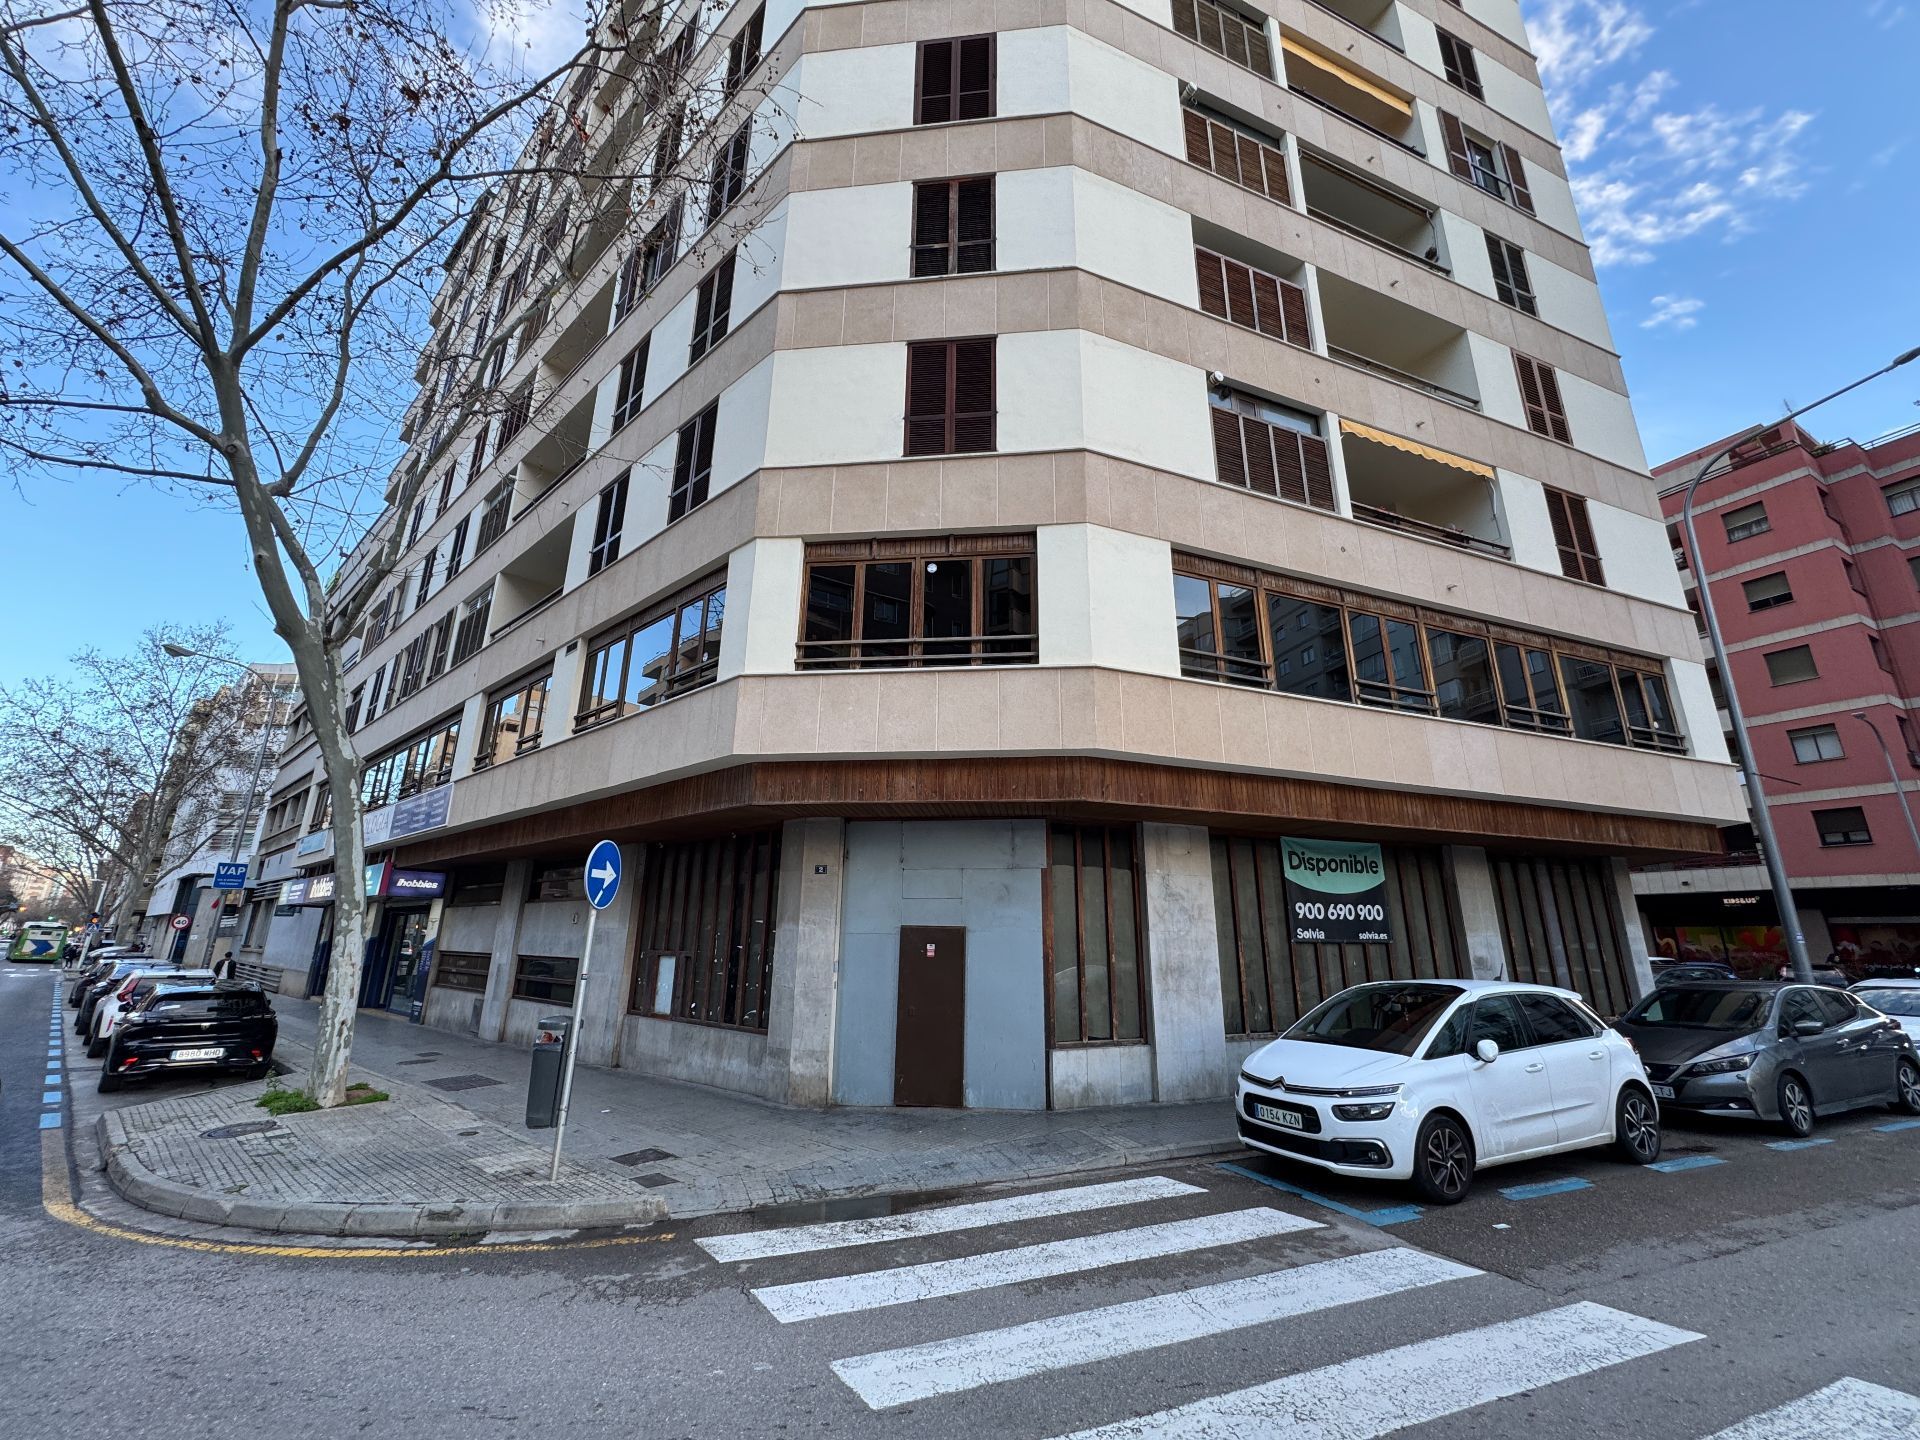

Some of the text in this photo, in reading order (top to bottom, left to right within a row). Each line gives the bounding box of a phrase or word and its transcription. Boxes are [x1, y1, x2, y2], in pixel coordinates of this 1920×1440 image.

[219, 865, 246, 876] VAP
[1287, 850, 1379, 877] Disponible
[1295, 902, 1384, 921] 900 690 900
[1296, 927, 1325, 940] Solvia
[1358, 931, 1388, 940] solvia.es
[1260, 1106, 1300, 1127] 0154 KZN
